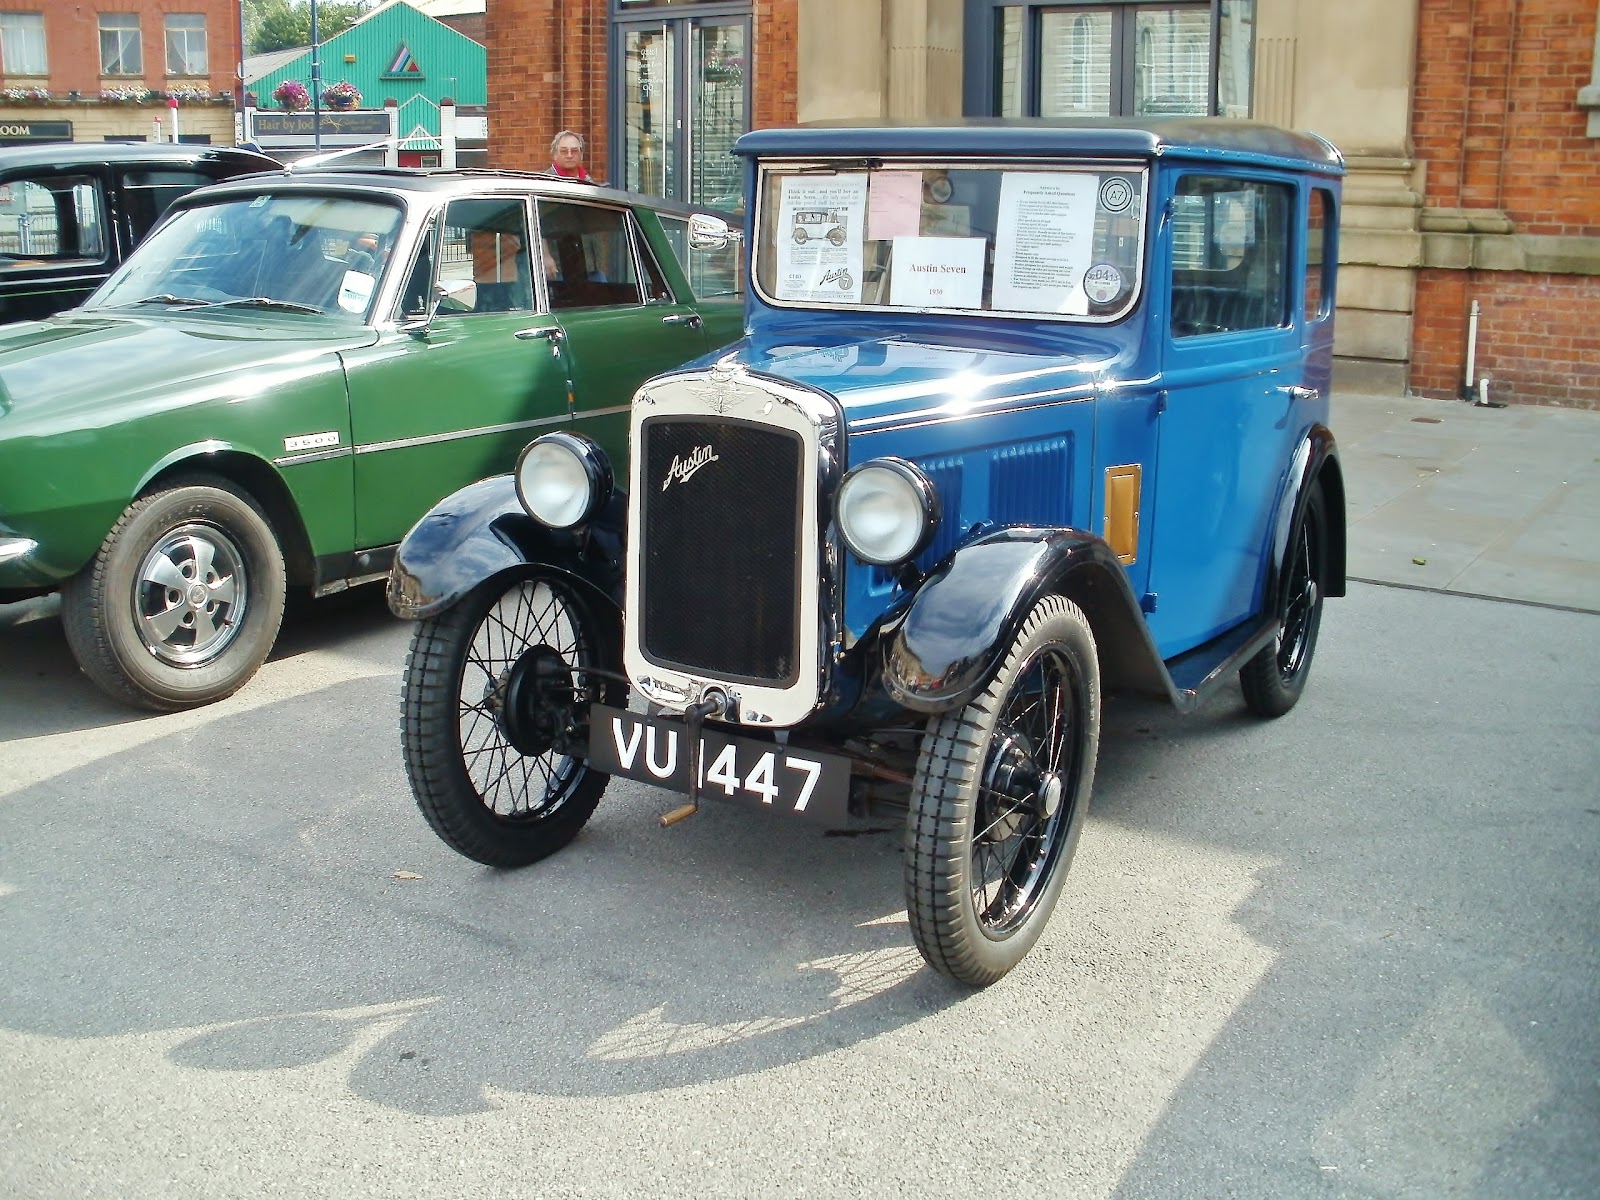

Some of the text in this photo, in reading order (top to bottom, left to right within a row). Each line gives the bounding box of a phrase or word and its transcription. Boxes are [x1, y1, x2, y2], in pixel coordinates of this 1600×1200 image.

[0, 125, 31, 136] OOM
[258, 118, 279, 130] Hair
[283, 117, 295, 132] by
[1110, 190, 1124, 201] A7
[909, 264, 966, 274] Austin Seven
[819, 268, 848, 286] Austin
[842, 276, 850, 288] 7
[289, 435, 336, 448] 3500
[662, 444, 719, 492] Austin
[612, 717, 678, 779] VU
